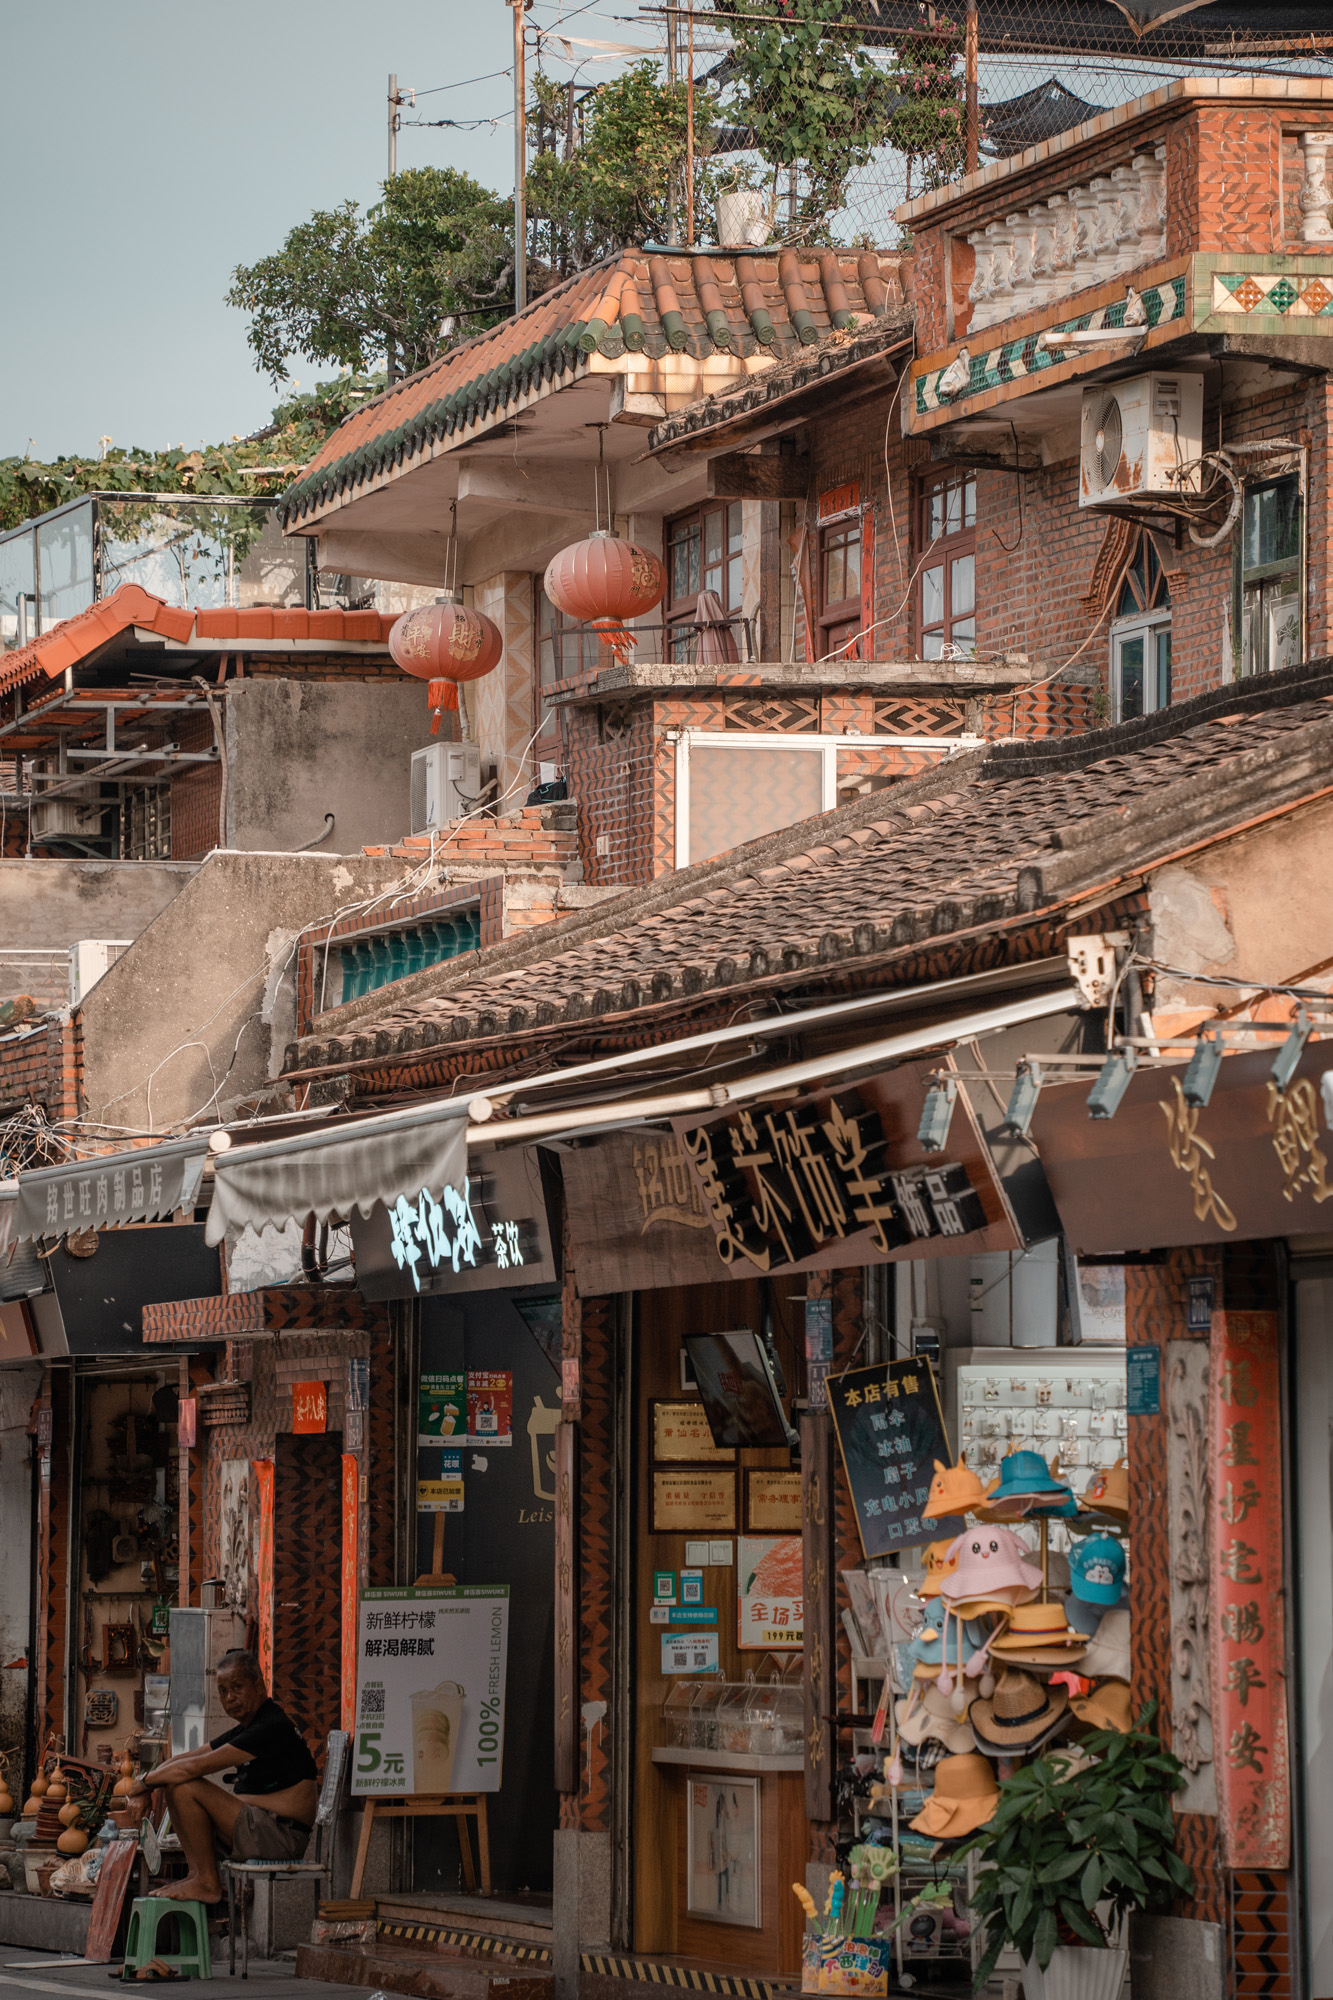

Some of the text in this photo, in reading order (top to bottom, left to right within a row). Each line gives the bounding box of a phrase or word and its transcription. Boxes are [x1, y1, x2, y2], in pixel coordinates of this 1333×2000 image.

[632, 1139, 703, 1217] 铭世
[46, 1162, 163, 1225] 铭世旺肉制品店
[491, 1220, 524, 1269] 茶饮
[420, 1374, 464, 1383] 微信扫码点餐
[844, 1374, 920, 1408] 本店有售
[869, 1409, 906, 1432] 雨伞
[877, 1434, 912, 1457] 冰袖
[443, 1459, 460, 1469] 花呗
[883, 1461, 917, 1485] 扇子
[1216, 1359, 1268, 1774] 福星护宅赐平安
[383, 1590, 408, 1598] SIWUKE
[366, 1610, 436, 1630] 新鲜柠檬
[364, 1637, 436, 1657] 解渴解腻
[477, 1607, 503, 1767] 100% FRESH LEMON
[356, 1732, 405, 1774] 5元
[355, 1777, 406, 1788] 新鲜柠檬冰爽
